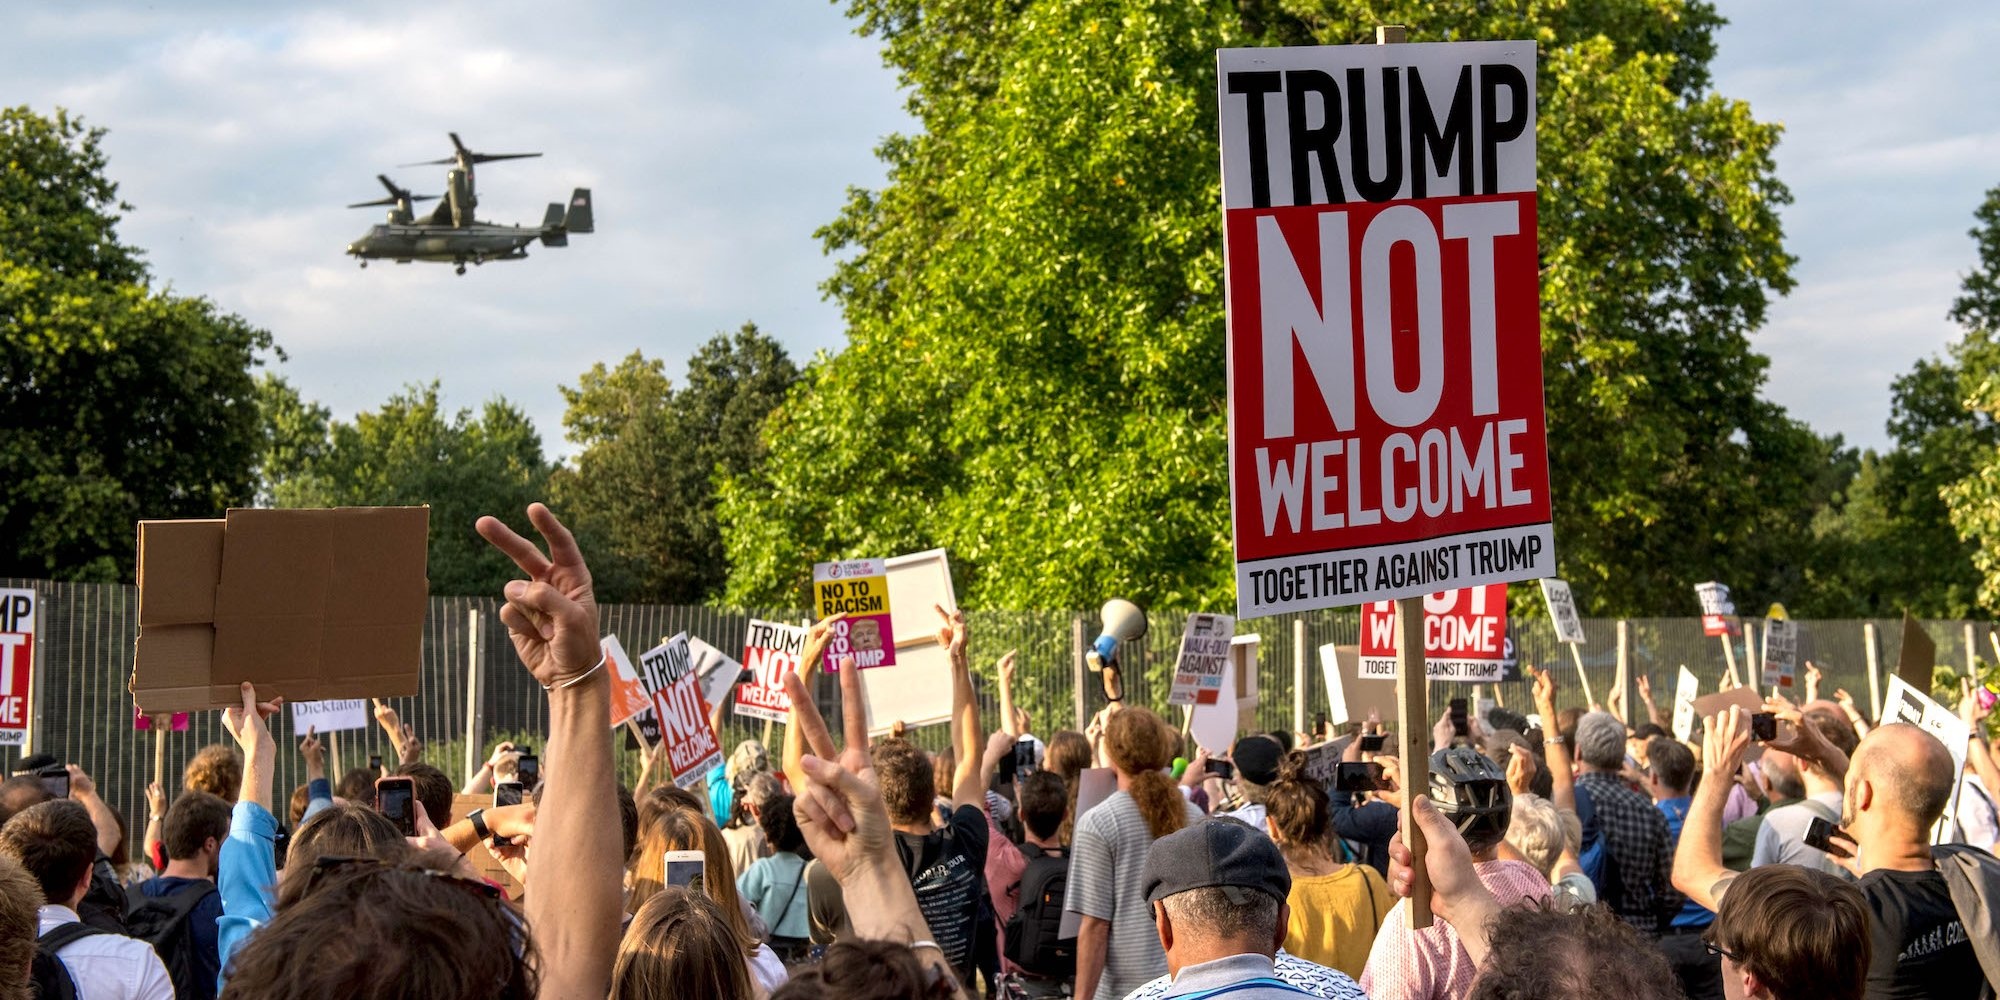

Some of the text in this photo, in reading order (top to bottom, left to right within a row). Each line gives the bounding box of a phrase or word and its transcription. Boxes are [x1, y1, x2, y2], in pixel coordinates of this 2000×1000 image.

[1228, 64, 1528, 208] TRUMP
[1256, 200, 1520, 440] NOT
[1255, 418, 1532, 537] WELCOME
[821, 581, 869, 600] NO TO
[1250, 558, 1368, 606] TOGETHER
[1375, 544, 1461, 591] AGAINST
[1466, 535, 1542, 574] TRUMP
[822, 595, 883, 616] RACISM
[752, 624, 807, 655] TRUM
[1184, 637, 1231, 656] WALK-OUT
[1370, 612, 1498, 653] WCOME
[644, 639, 690, 692] TRUMP
[1178, 654, 1227, 676] AGAINST
[1426, 661, 1461, 677] GAINST
[1464, 662, 1498, 677] TRUMP
[657, 671, 705, 748] NOT
[670, 725, 716, 772] WELCOME
